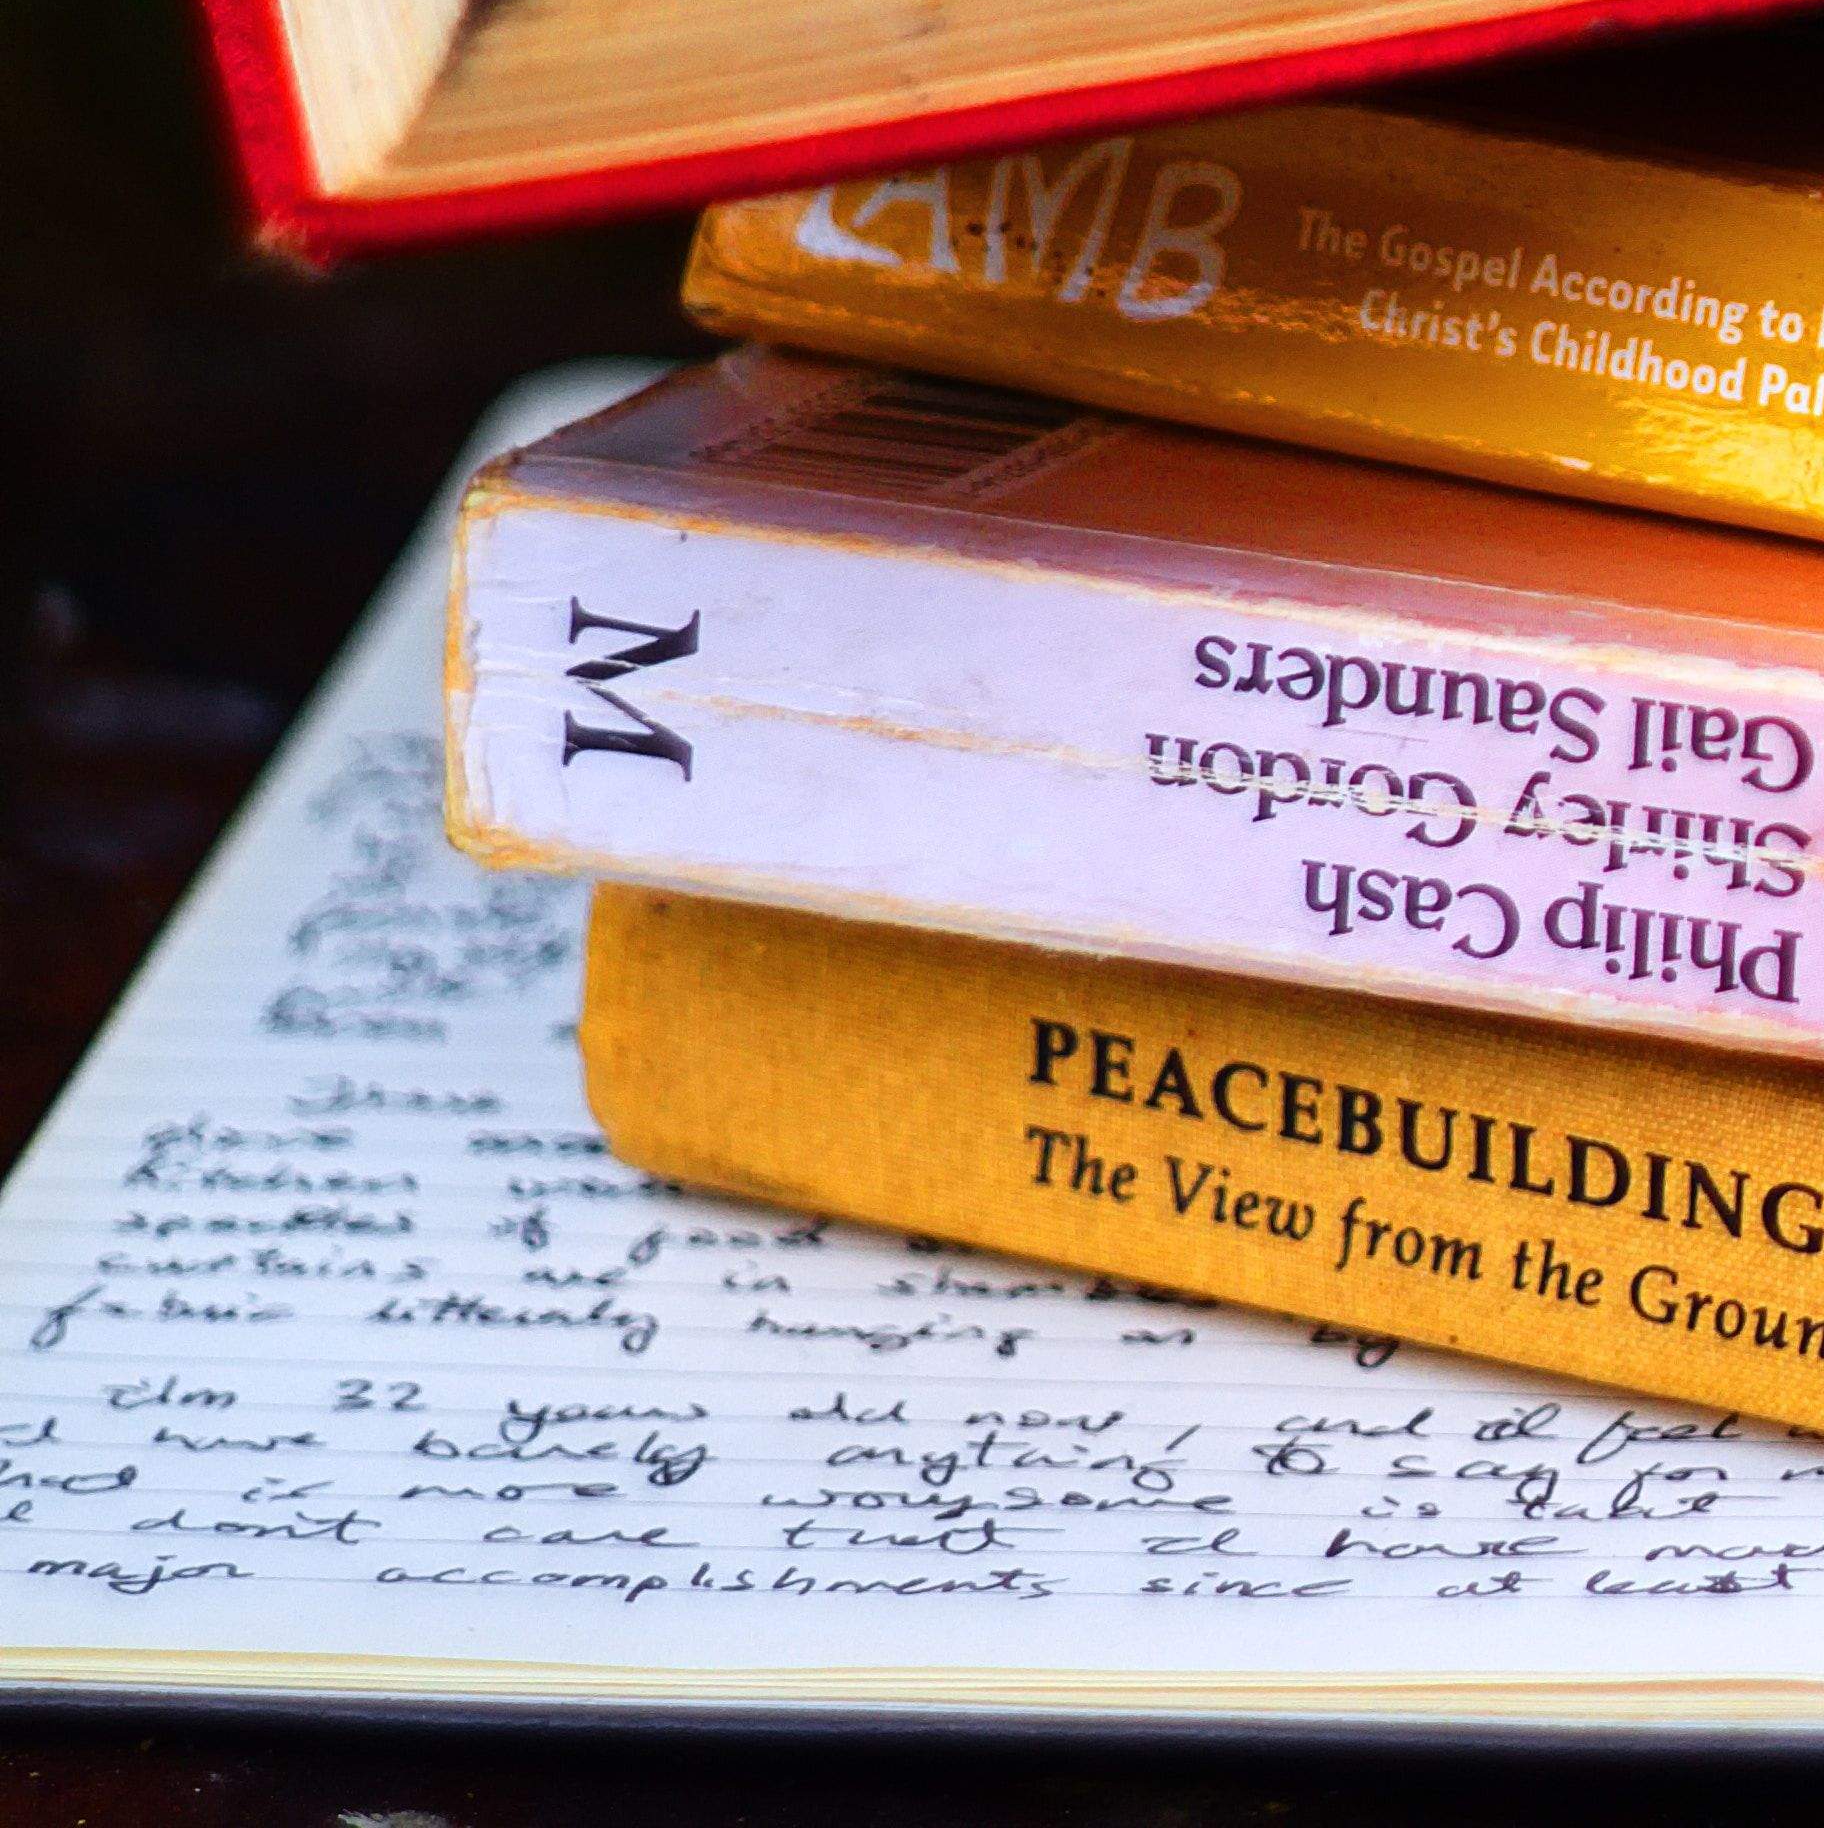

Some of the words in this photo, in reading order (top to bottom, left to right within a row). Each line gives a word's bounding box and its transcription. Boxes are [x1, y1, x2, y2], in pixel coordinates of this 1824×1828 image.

[1300, 206, 1366, 260] The
[1379, 223, 1521, 291] Gospel
[1530, 253, 1748, 346] According
[1759, 298, 1804, 343] to
[1358, 287, 1518, 358] Christ's
[1530, 320, 1747, 402] Childhood
[562, 595, 700, 784] M
[1193, 634, 1606, 766] Saunders
[1627, 696, 1815, 794] Gail
[1144, 732, 1478, 848] Gordon
[1502, 771, 1813, 898] Shirley
[1301, 858, 1520, 960] Cash
[1542, 879, 1804, 1004] Philip
[1028, 1017, 1824, 1257] PEACEBUILDING
[1025, 1124, 1139, 1206] The
[1162, 1153, 1316, 1242] View
[1333, 1197, 1485, 1279] from
[1511, 1236, 1605, 1308] the
[103, 1374, 239, 1410] I'm
[333, 1377, 429, 1413] 32
[500, 1397, 711, 1444] years
[788, 1392, 911, 1424] old
[1275, 1406, 1437, 1438] and
[1473, 1401, 1562, 1442] I
[153, 1425, 328, 1453] have
[413, 1428, 718, 1488] barely
[827, 1428, 1188, 1494] anything
[1250, 1434, 1342, 1476] to
[1386, 1451, 1561, 1505] say
[27, 1552, 256, 1596] major
[375, 1561, 1070, 1603] accomplishments
[1140, 1570, 1353, 1598] since
[1435, 1569, 1555, 1599] at
[130, 1508, 383, 1545] don't
[483, 1524, 701, 1550] care
[1323, 1525, 1590, 1560] have
